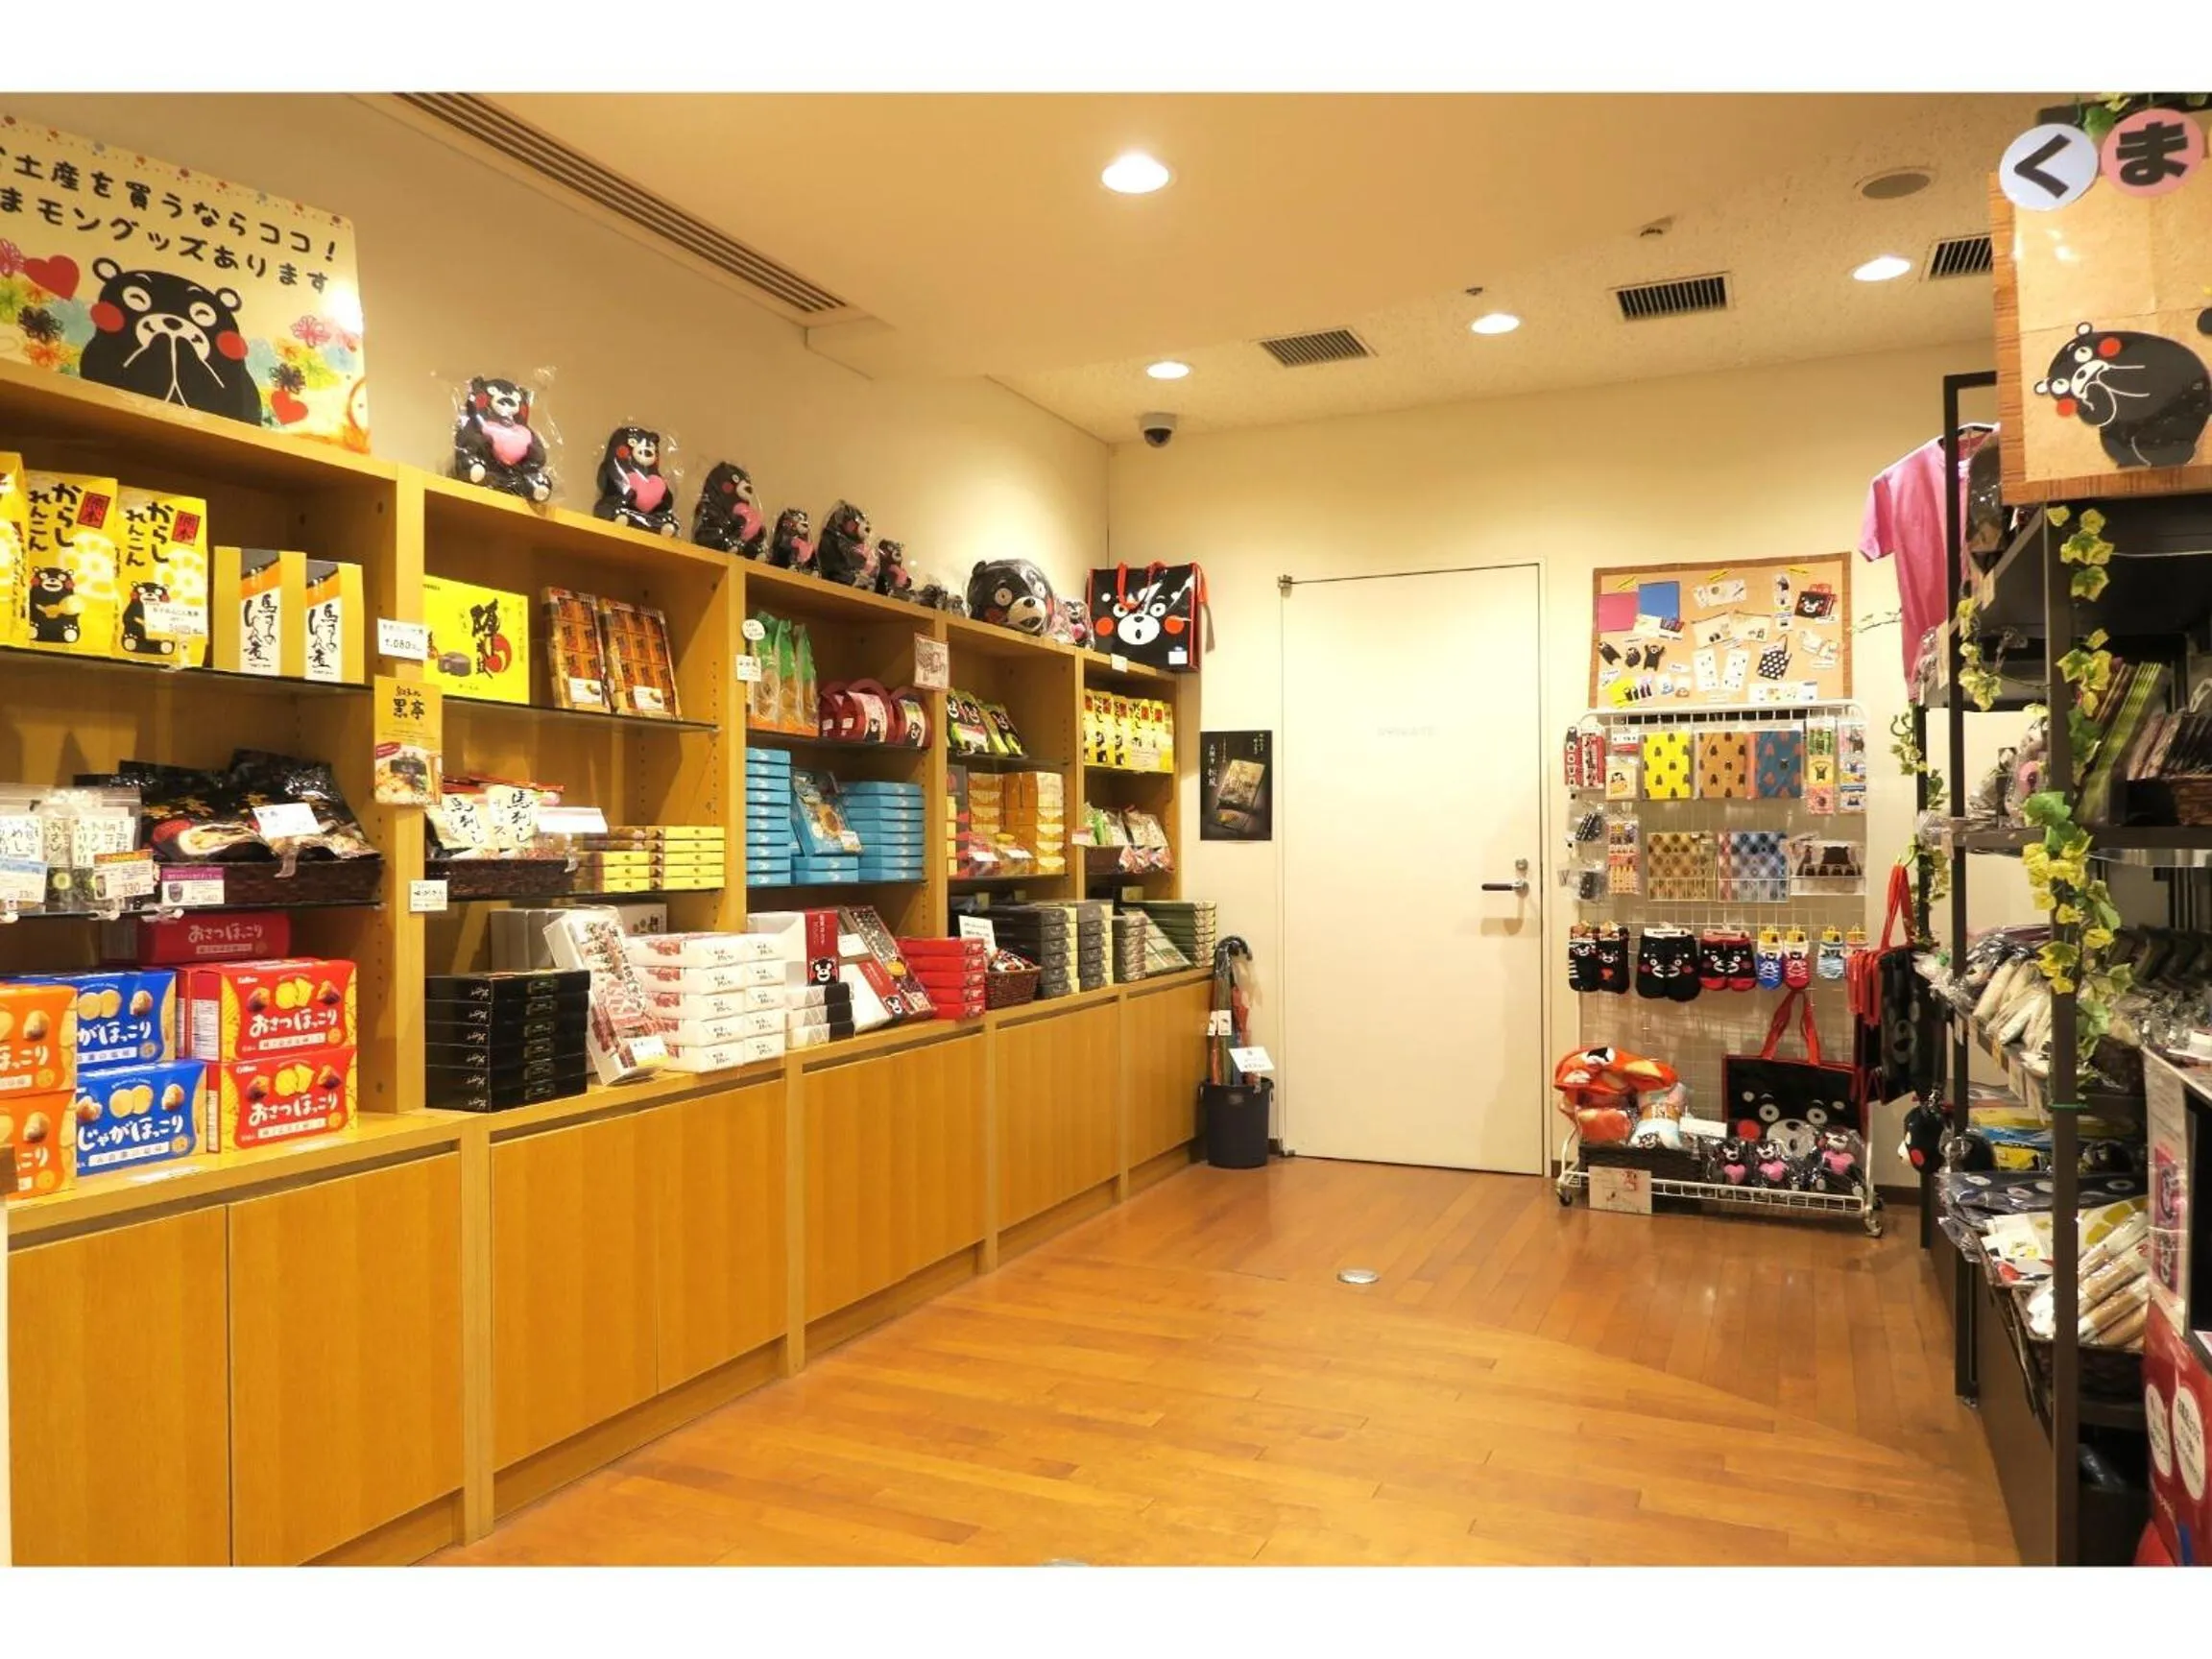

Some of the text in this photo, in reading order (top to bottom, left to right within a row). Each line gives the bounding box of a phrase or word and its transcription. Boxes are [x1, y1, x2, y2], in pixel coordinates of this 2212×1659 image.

[0, 147, 335, 262] 土産を買うならココ！
[188, 923, 262, 942] おさつほっこり
[250, 1008, 337, 1037] おさつほっこり
[249, 1094, 338, 1126] おさつほっこり
[78, 1115, 184, 1151] じゃがほっこり
